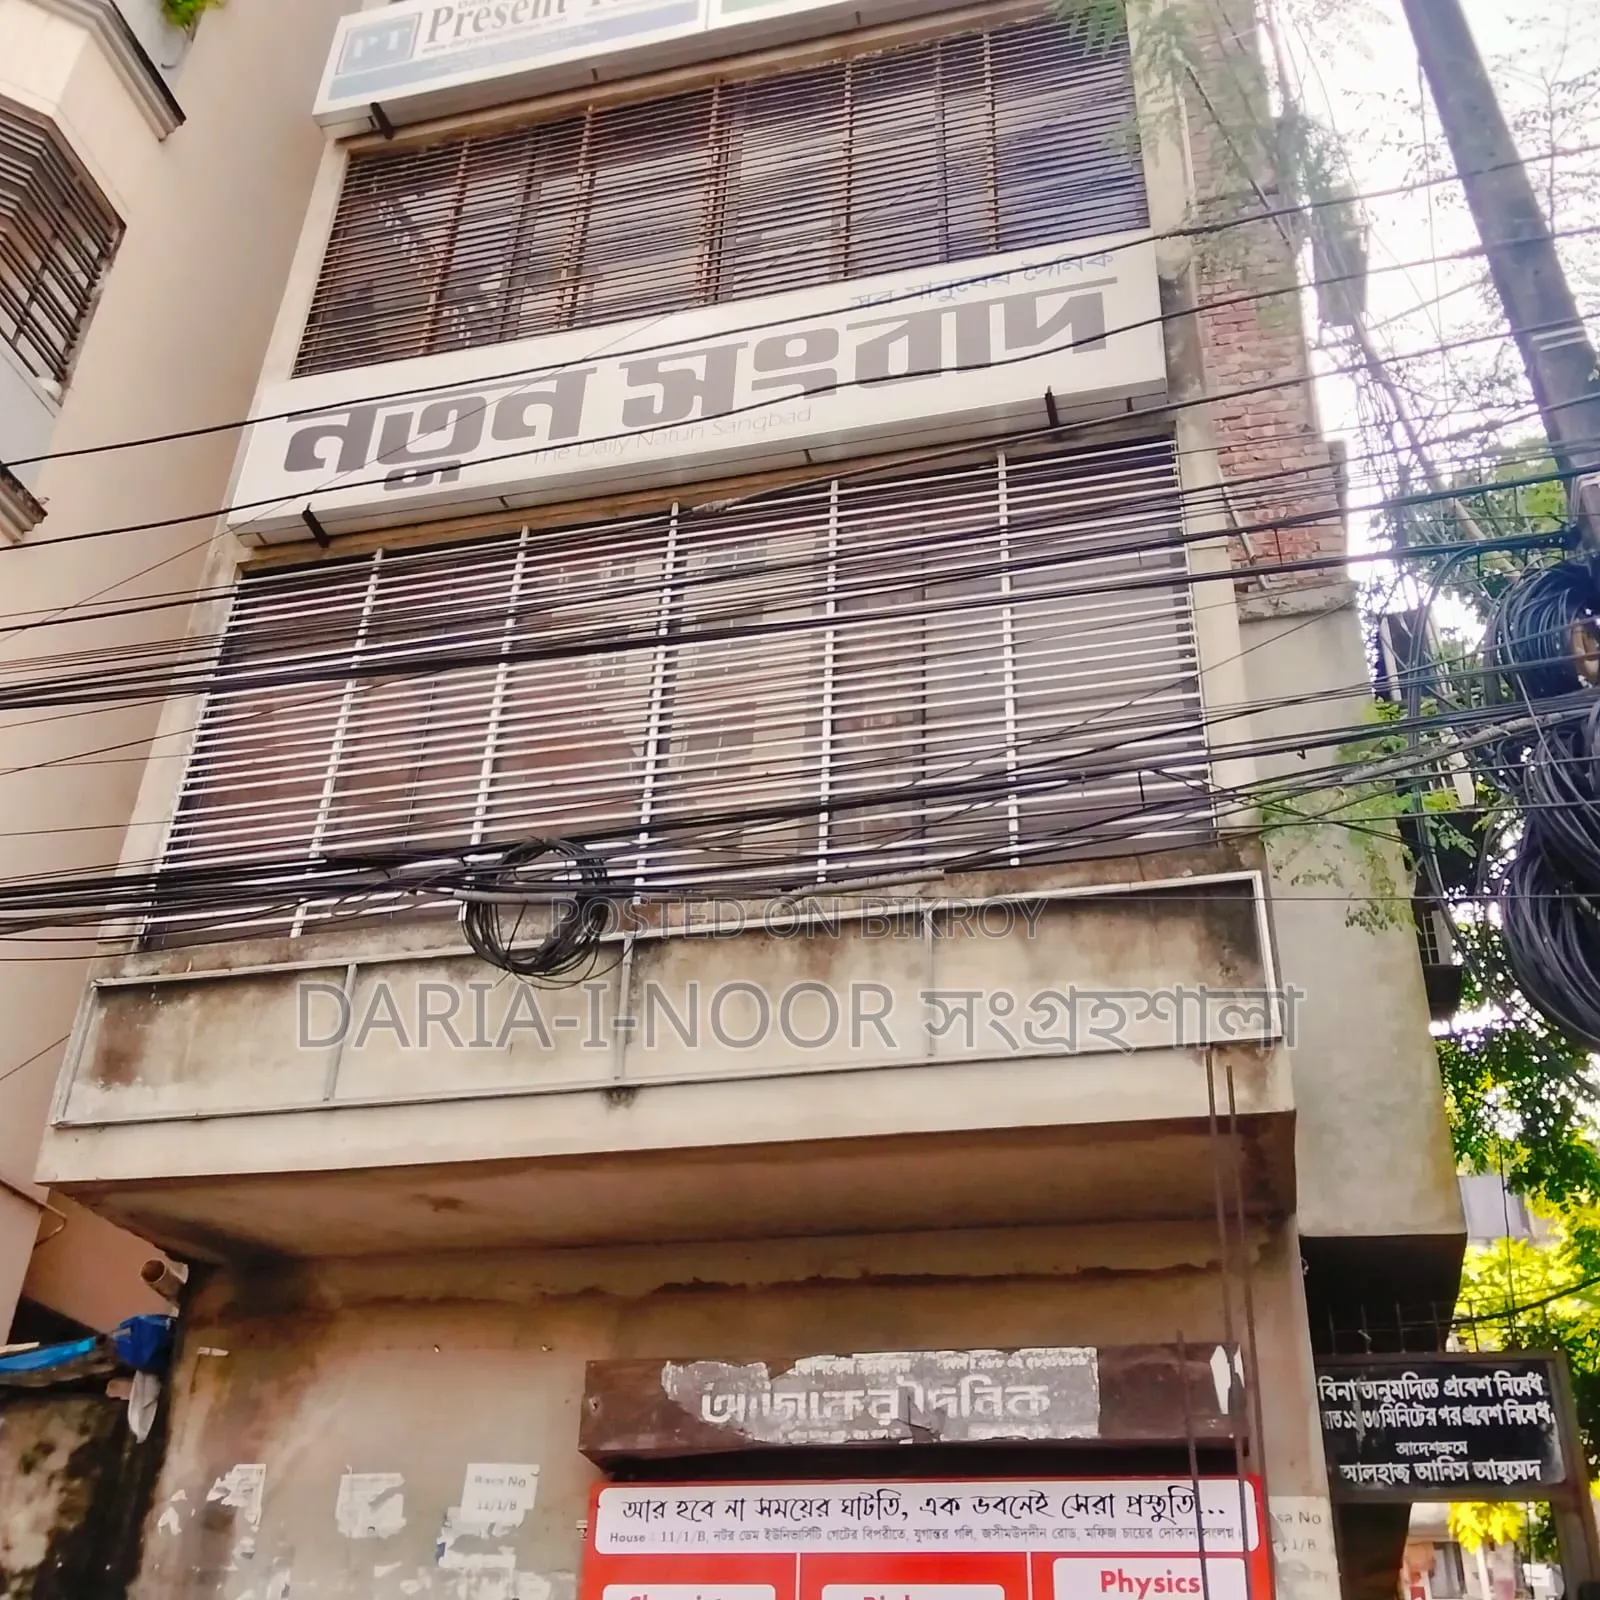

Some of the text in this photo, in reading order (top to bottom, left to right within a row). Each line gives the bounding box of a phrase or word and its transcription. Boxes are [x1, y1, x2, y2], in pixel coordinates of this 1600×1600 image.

[283, 276, 1118, 491] নতুন সংবাদ
[712, 407, 811, 437] Sangbad
[1318, 1375, 1358, 1401] বিনা
[1443, 1374, 1493, 1398] প্রবেশ
[1462, 1403, 1503, 1426] প্রবেশ
[1413, 1455, 1469, 1481] আনিস
[508, 1475, 526, 1488] No
[621, 1499, 669, 1523] আর
[675, 1499, 715, 1522] হবে
[725, 1497, 745, 1522] না
[754, 1497, 832, 1521] সময়ের
[838, 1488, 908, 1521] ঘাটতি,
[919, 1496, 964, 1517] এক
[970, 1489, 1055, 1519] ভবনেই
[1061, 1493, 1116, 1518] সেরা
[1299, 1511, 1322, 1524] No
[609, 1532, 646, 1543] House
[1100, 1569, 1201, 1600] Physics
